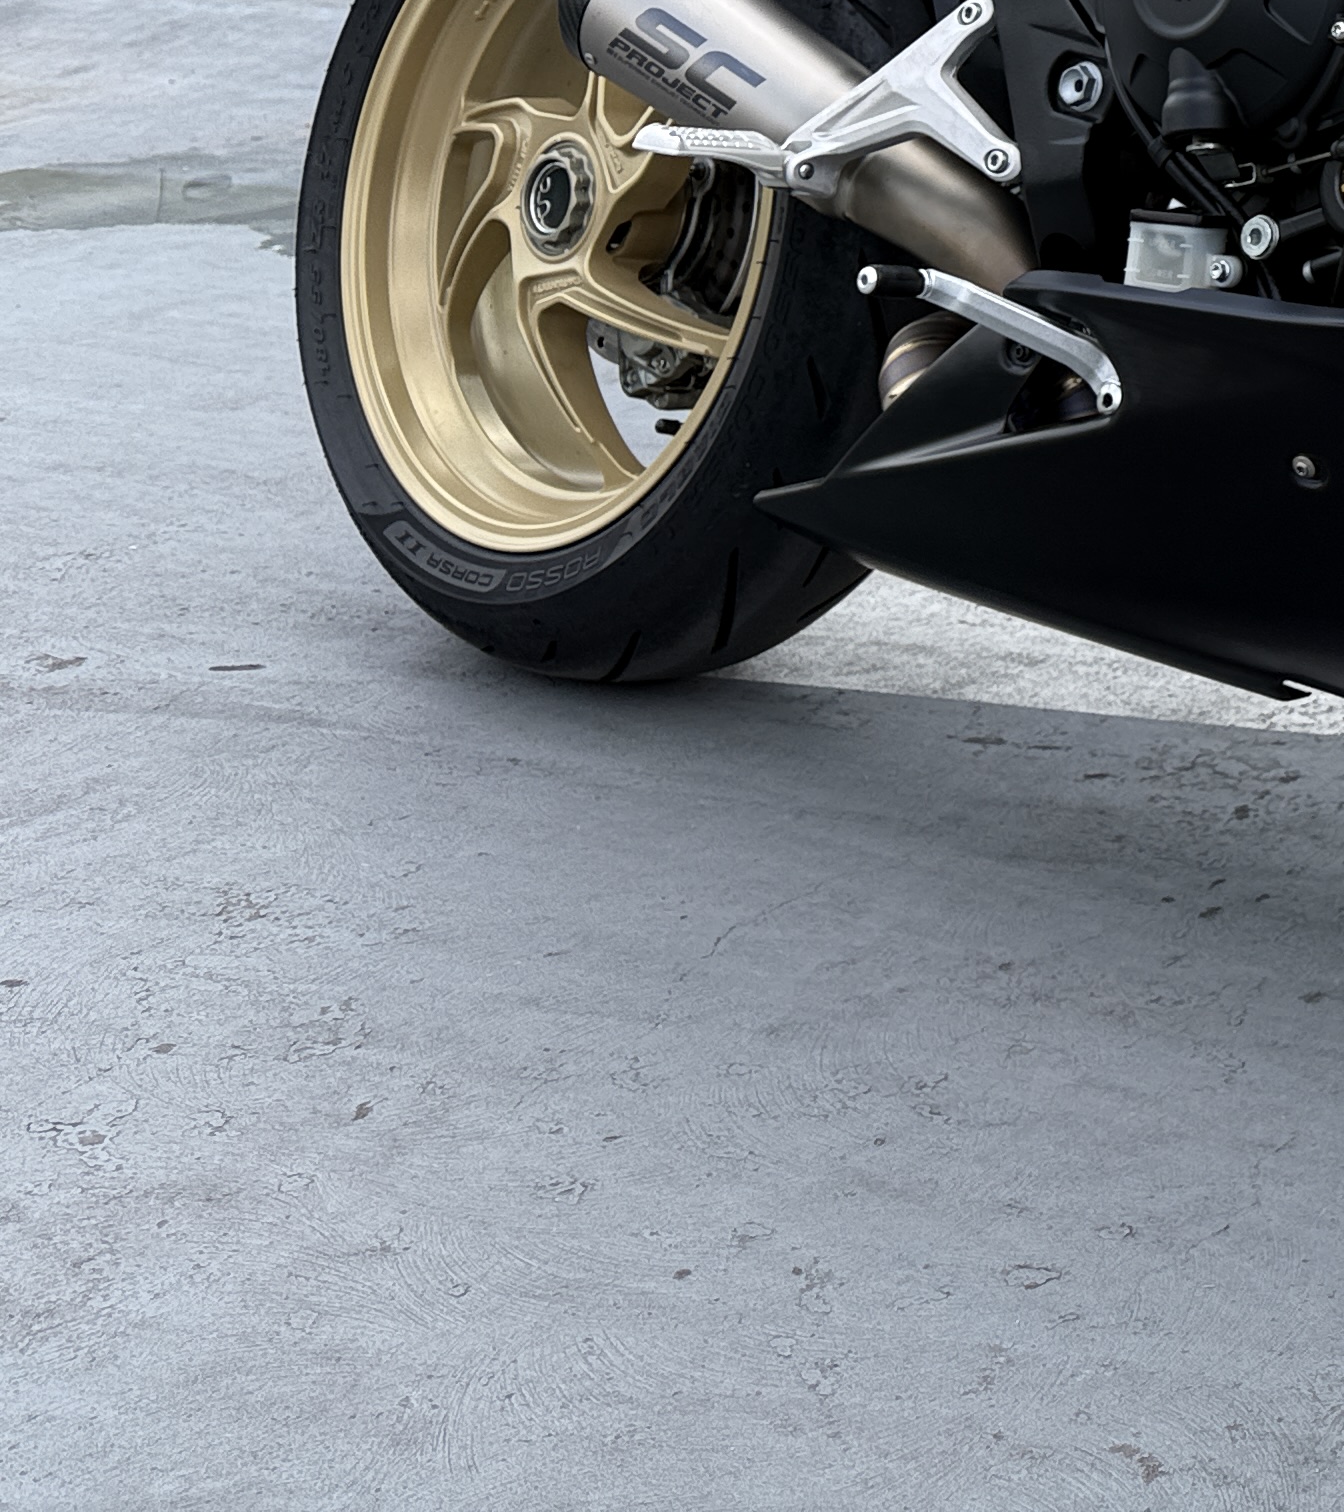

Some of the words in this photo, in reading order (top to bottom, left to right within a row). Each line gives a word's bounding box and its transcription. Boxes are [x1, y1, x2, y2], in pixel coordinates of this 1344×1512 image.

[607, 38, 729, 120] PROJECT
[618, 7, 767, 111] SC
[426, 553, 494, 587] CORSA
[505, 549, 600, 592] ROSSO
